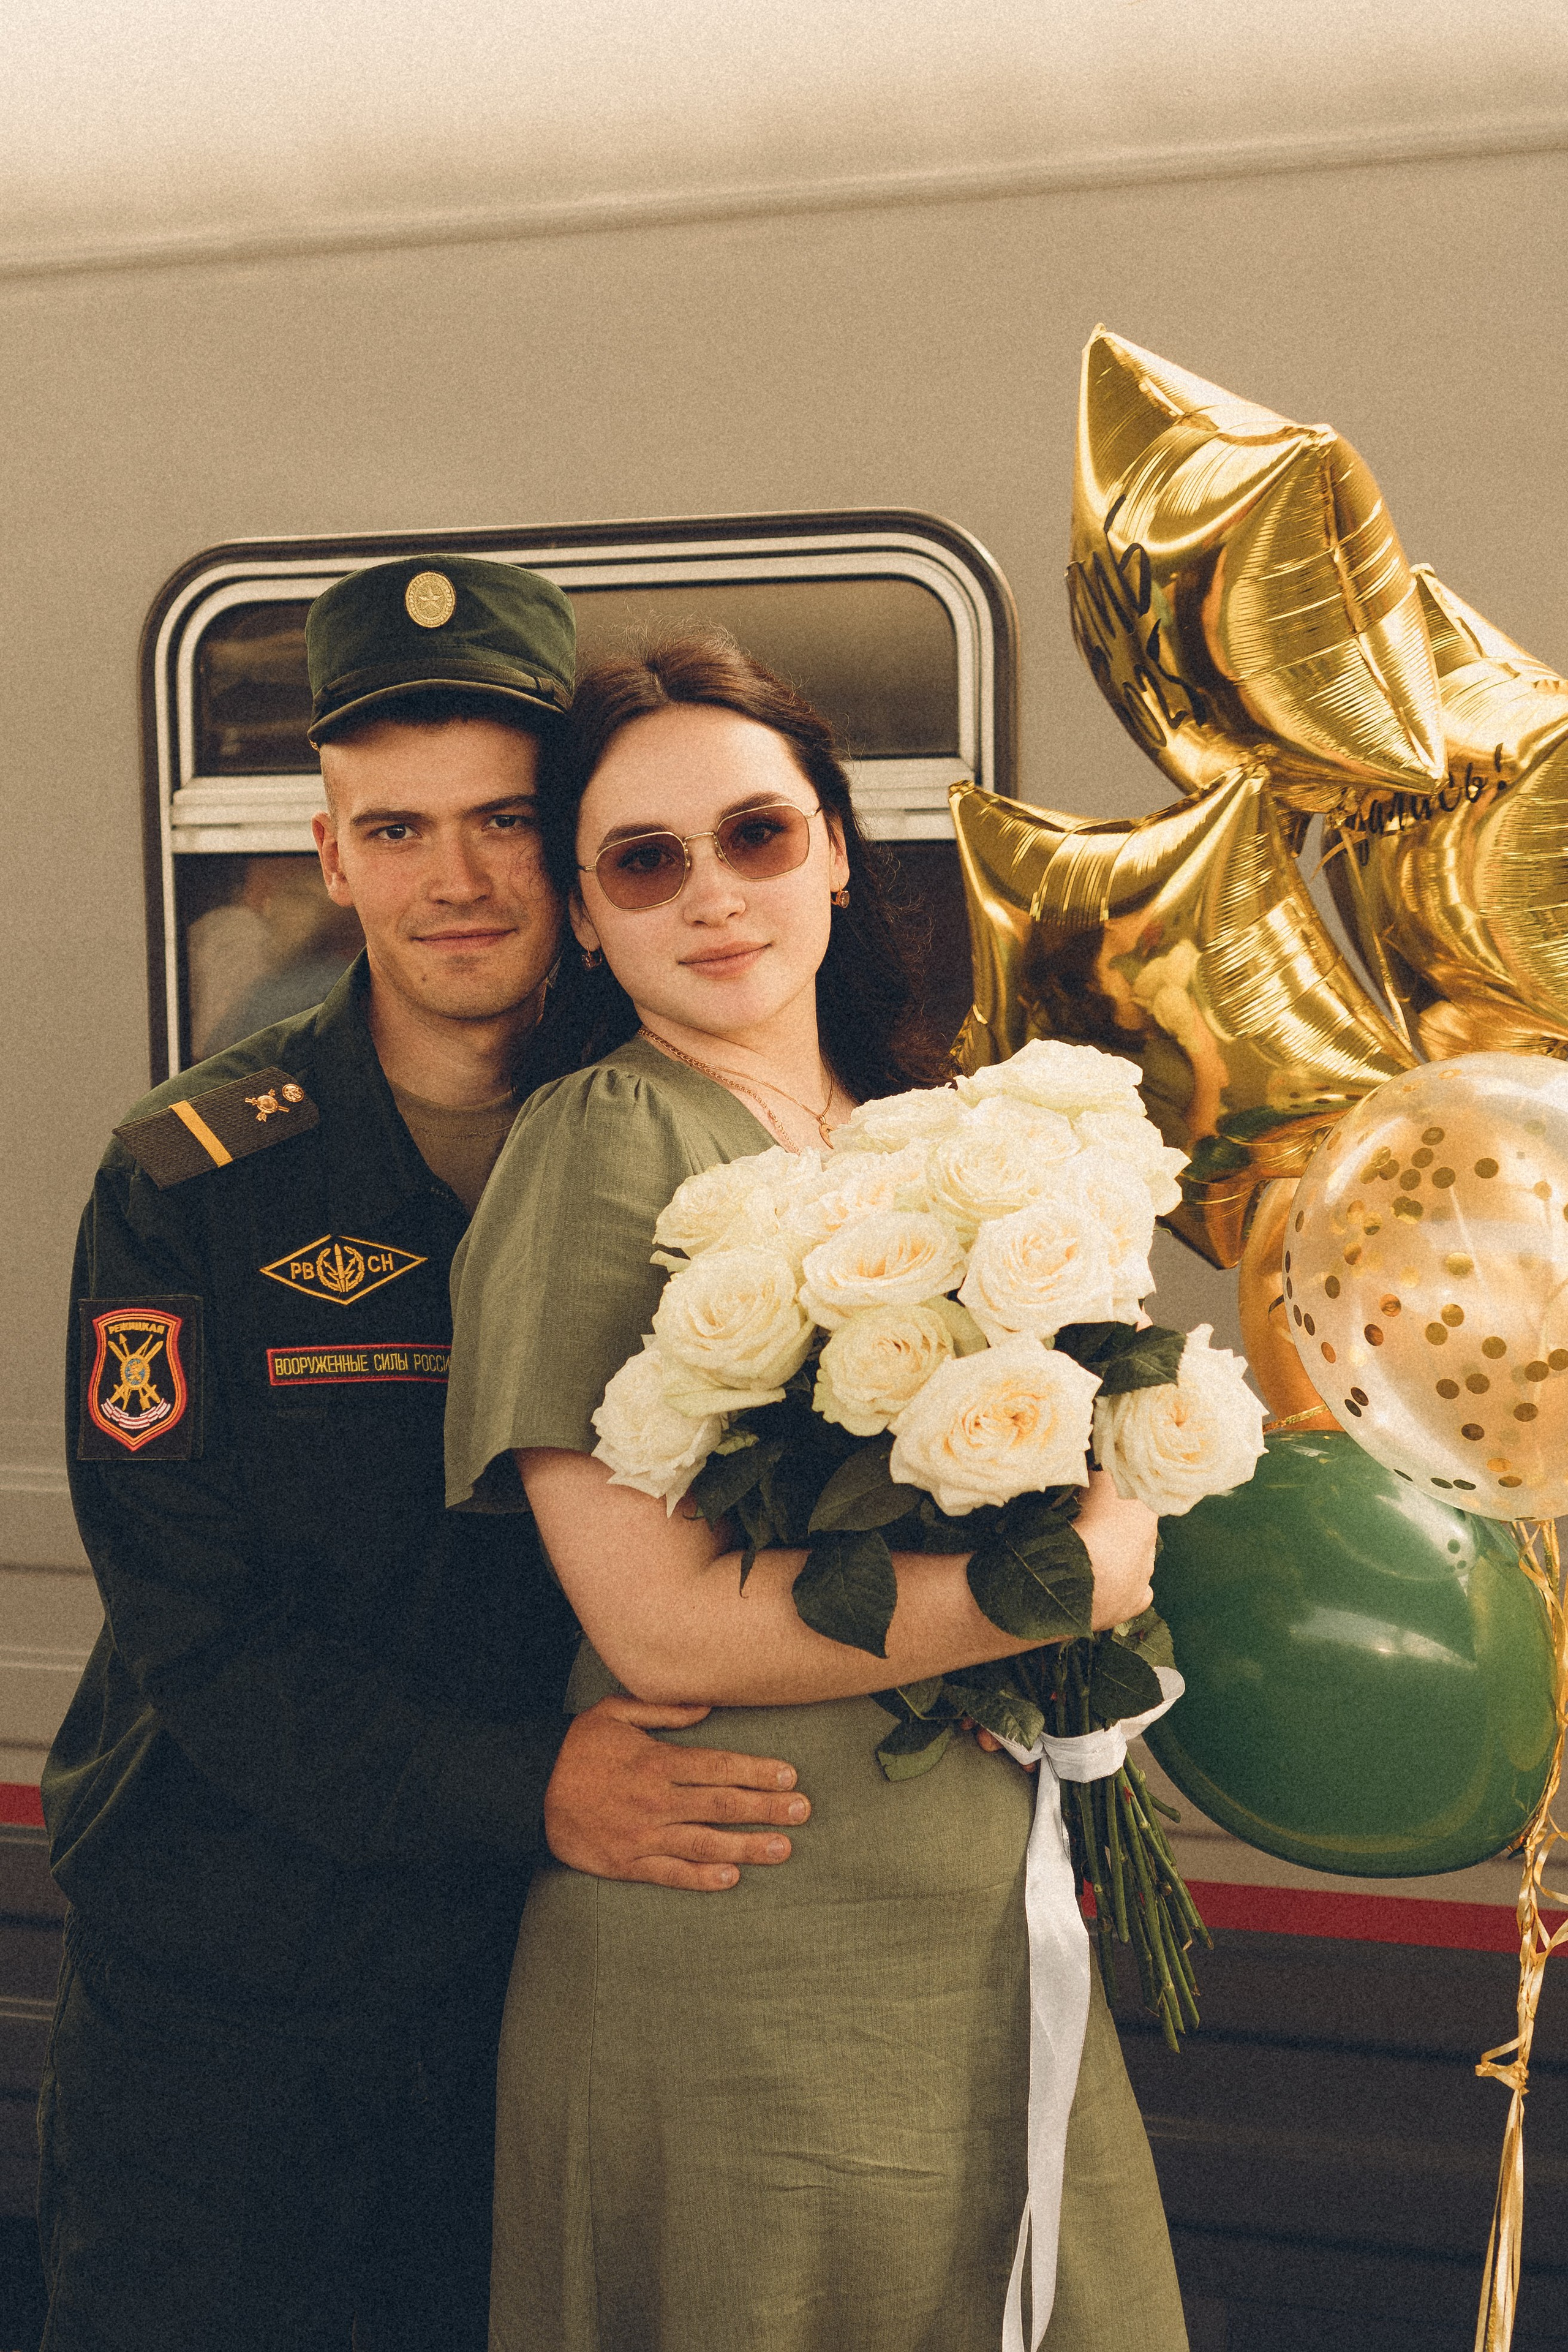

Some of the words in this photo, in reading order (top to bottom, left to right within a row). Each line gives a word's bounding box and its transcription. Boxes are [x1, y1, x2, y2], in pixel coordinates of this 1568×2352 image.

[290, 1262, 315, 1280] РВ
[368, 1253, 394, 1273] СН
[274, 1354, 369, 1376] ВООРУЖЕННЫЕ
[374, 1352, 409, 1371] СИЛЫ
[413, 1353, 451, 1372] РОССИ
